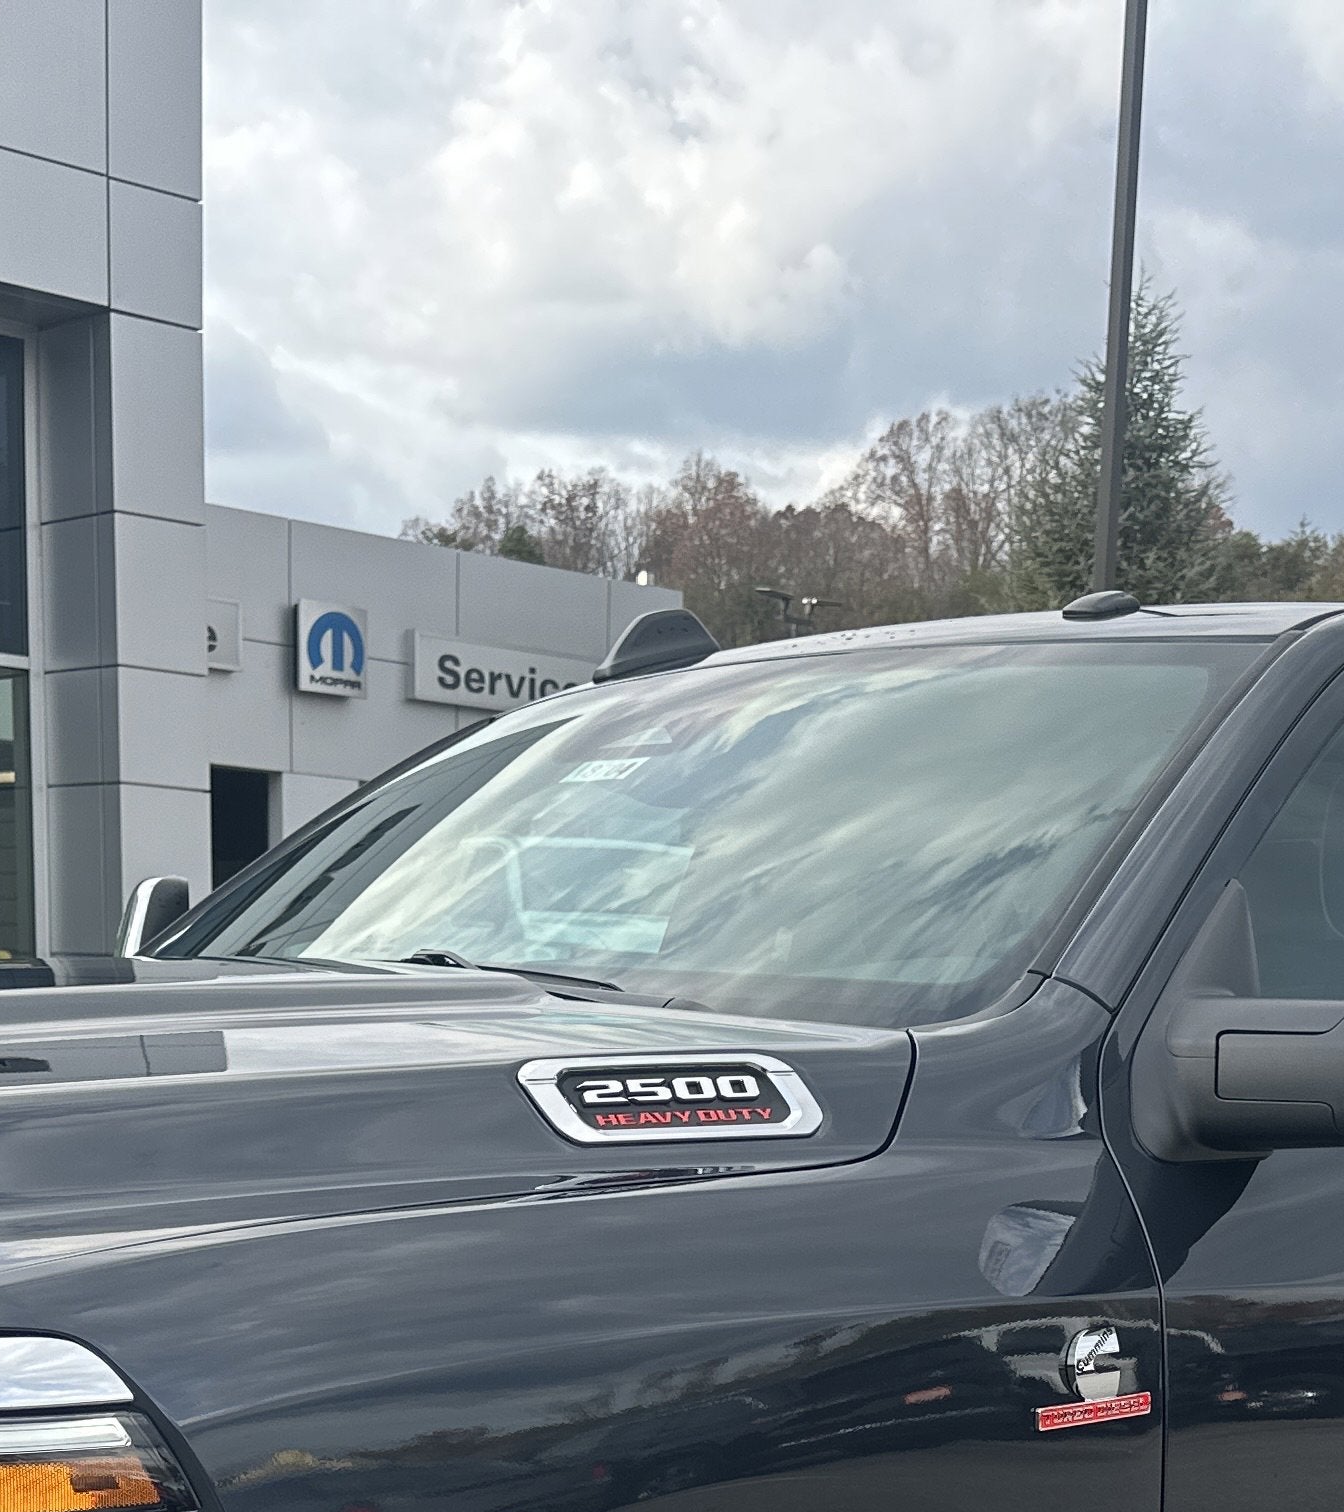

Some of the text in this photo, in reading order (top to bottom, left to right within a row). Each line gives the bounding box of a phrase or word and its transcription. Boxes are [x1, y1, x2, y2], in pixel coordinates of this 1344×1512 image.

[437, 654, 578, 701] Servic
[575, 1074, 761, 1105] 2500
[594, 1107, 772, 1128] HEAVY DUTY
[1076, 1327, 1115, 1372] Cummins
